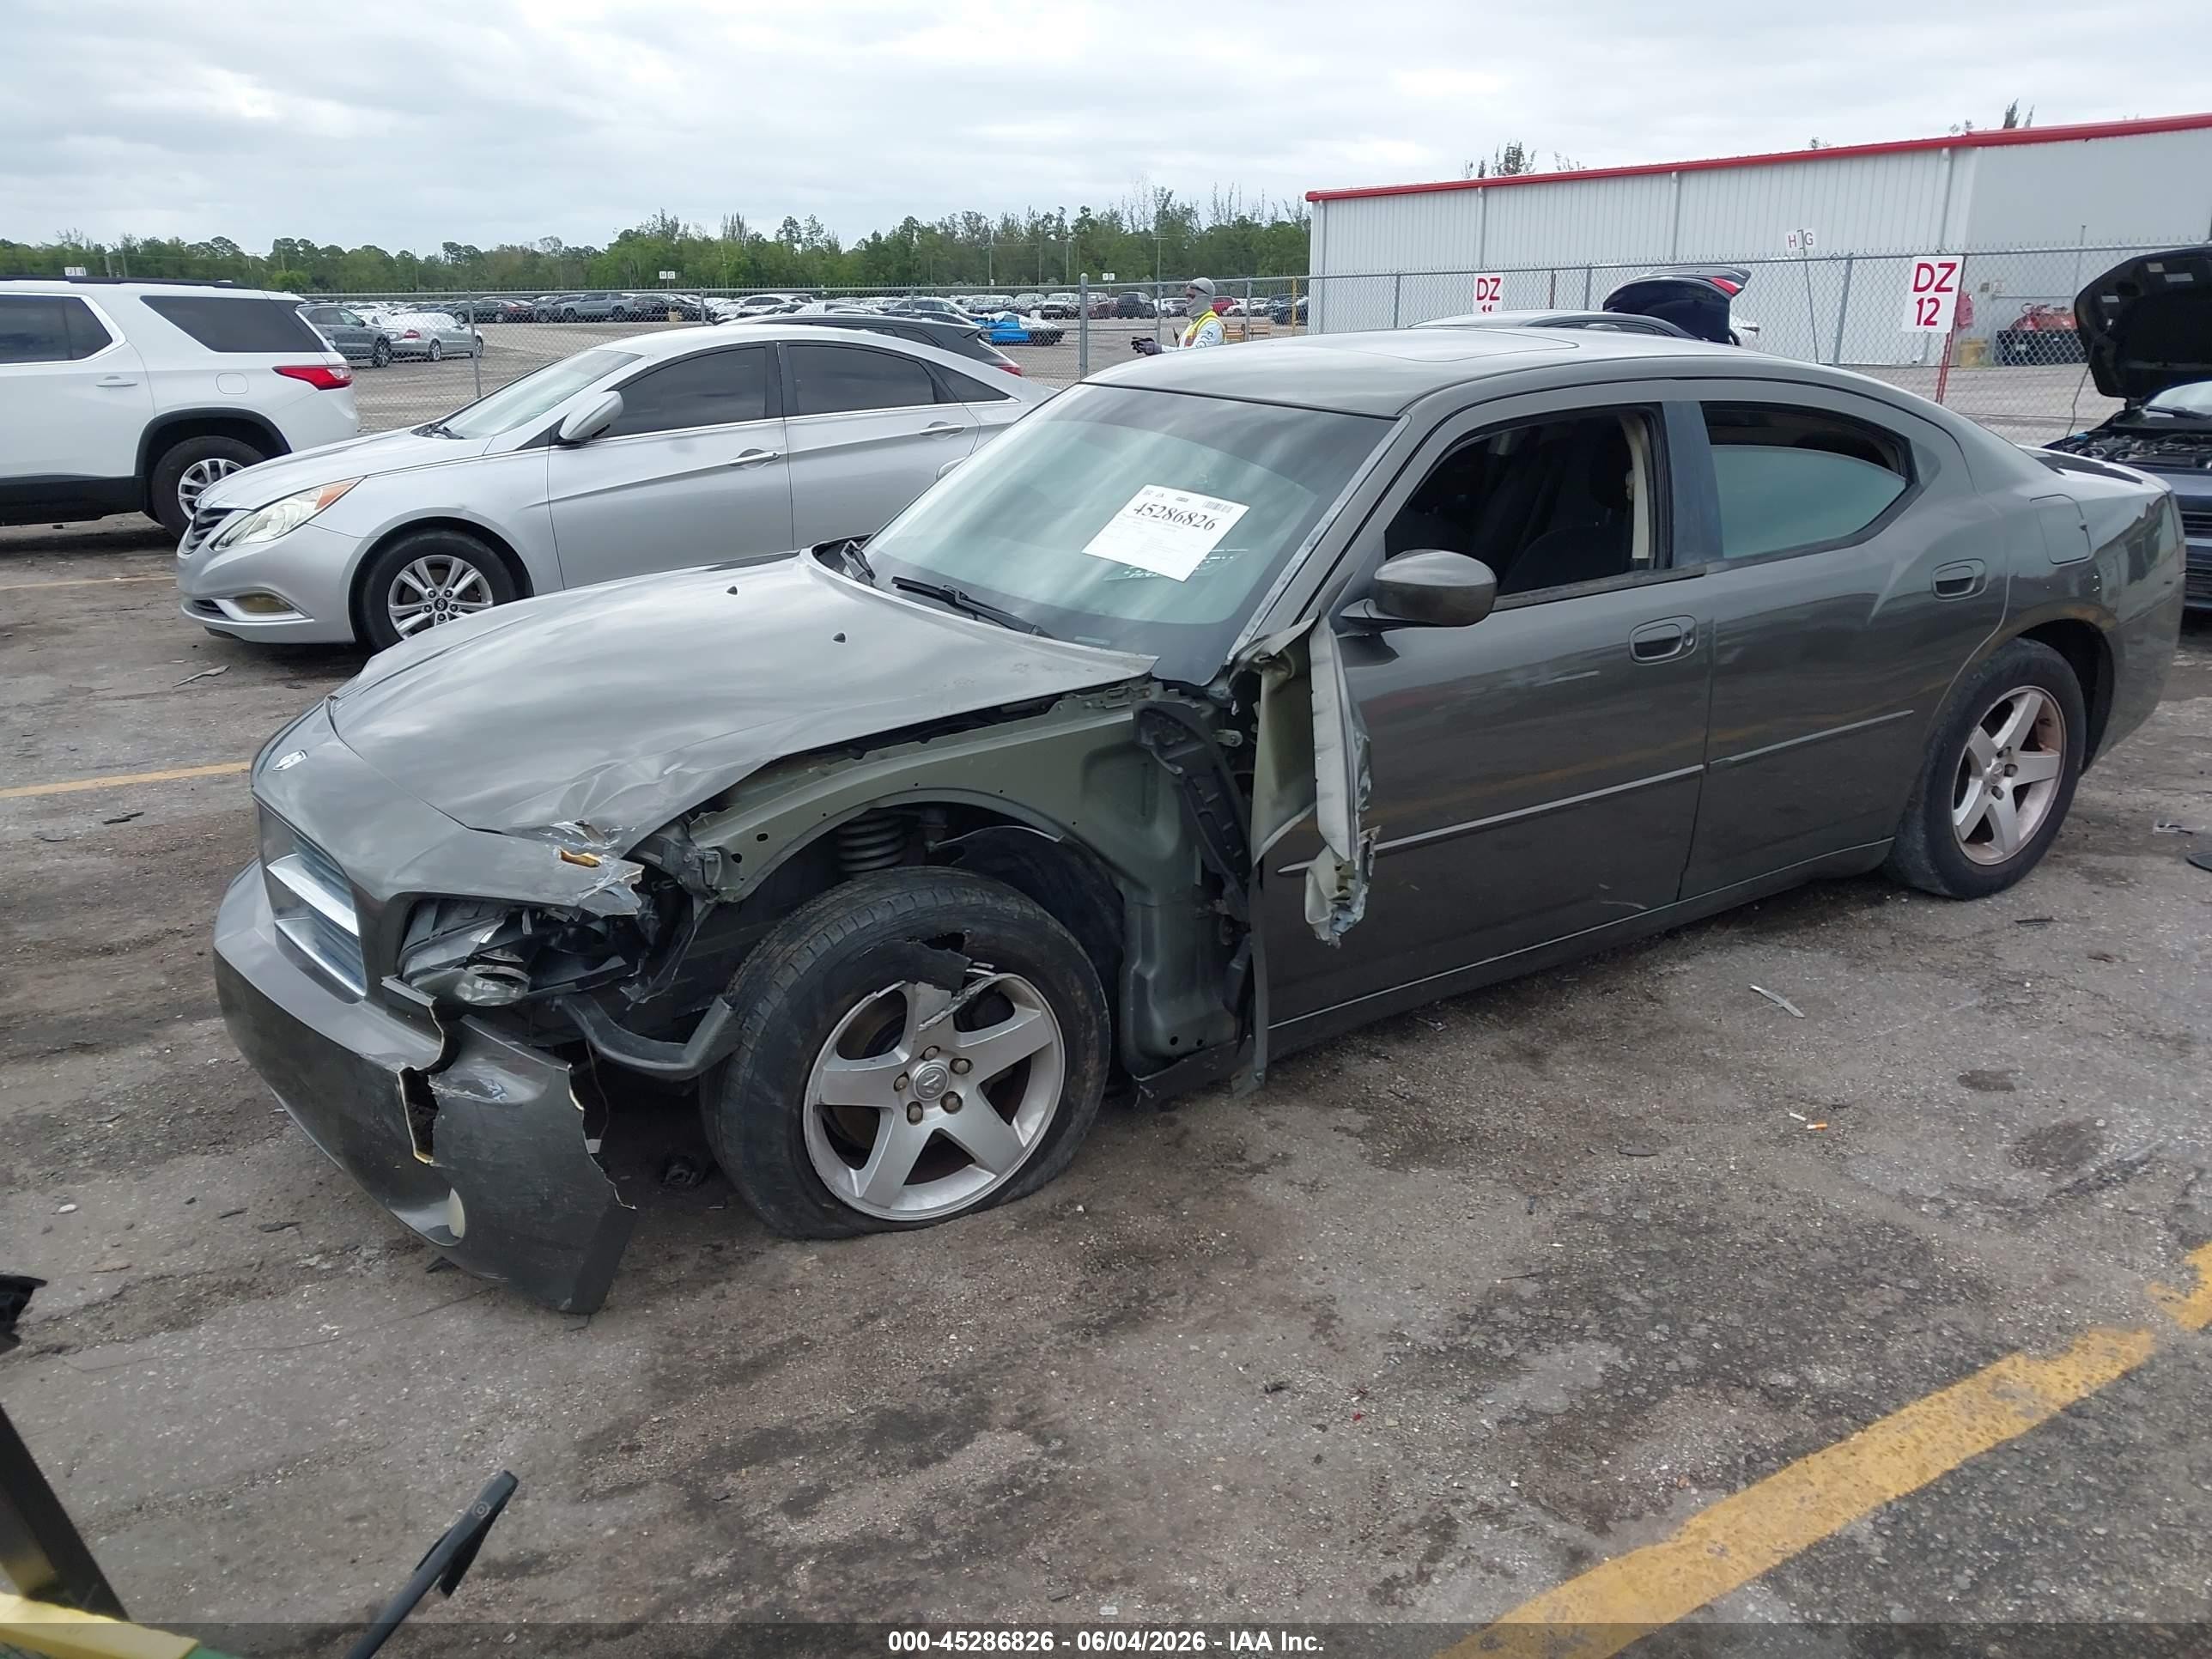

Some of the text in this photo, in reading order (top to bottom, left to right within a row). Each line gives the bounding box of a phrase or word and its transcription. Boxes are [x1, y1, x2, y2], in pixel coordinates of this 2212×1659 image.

[1788, 232, 1814, 248] H G
[1476, 277, 1501, 301] DZ
[1913, 263, 1957, 292] DZ
[1916, 297, 1941, 326] 12
[1133, 501, 1221, 531] 45286826
